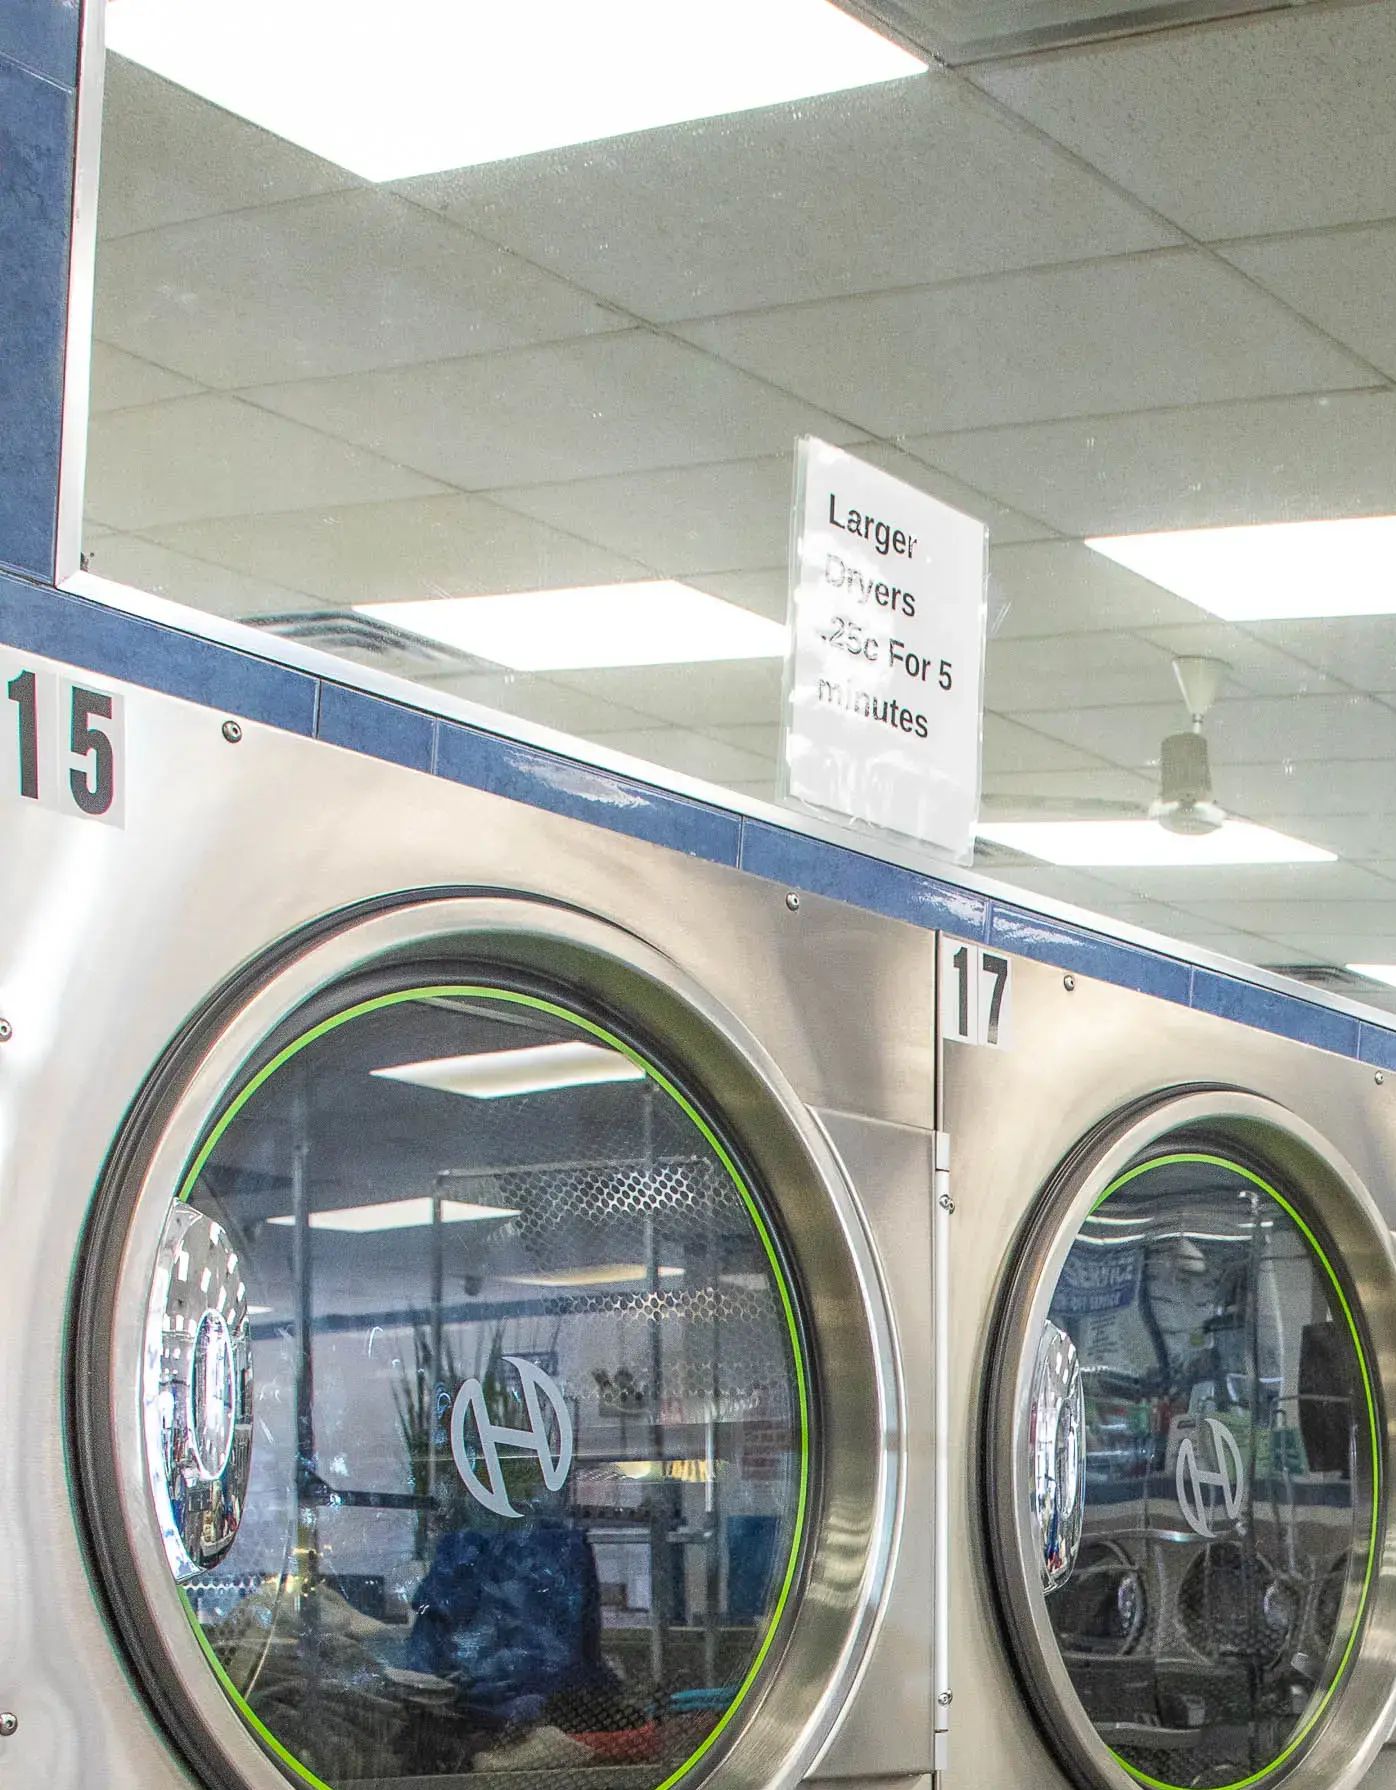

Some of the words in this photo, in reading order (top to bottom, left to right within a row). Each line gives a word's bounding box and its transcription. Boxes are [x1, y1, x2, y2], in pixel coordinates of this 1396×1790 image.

[829, 493, 917, 558] Larger
[825, 553, 916, 617] Dryers
[889, 638, 931, 681] For
[938, 659, 952, 691] 5
[818, 677, 929, 738] minutes
[8, 669, 113, 815] 15
[954, 946, 1007, 1044] 17
